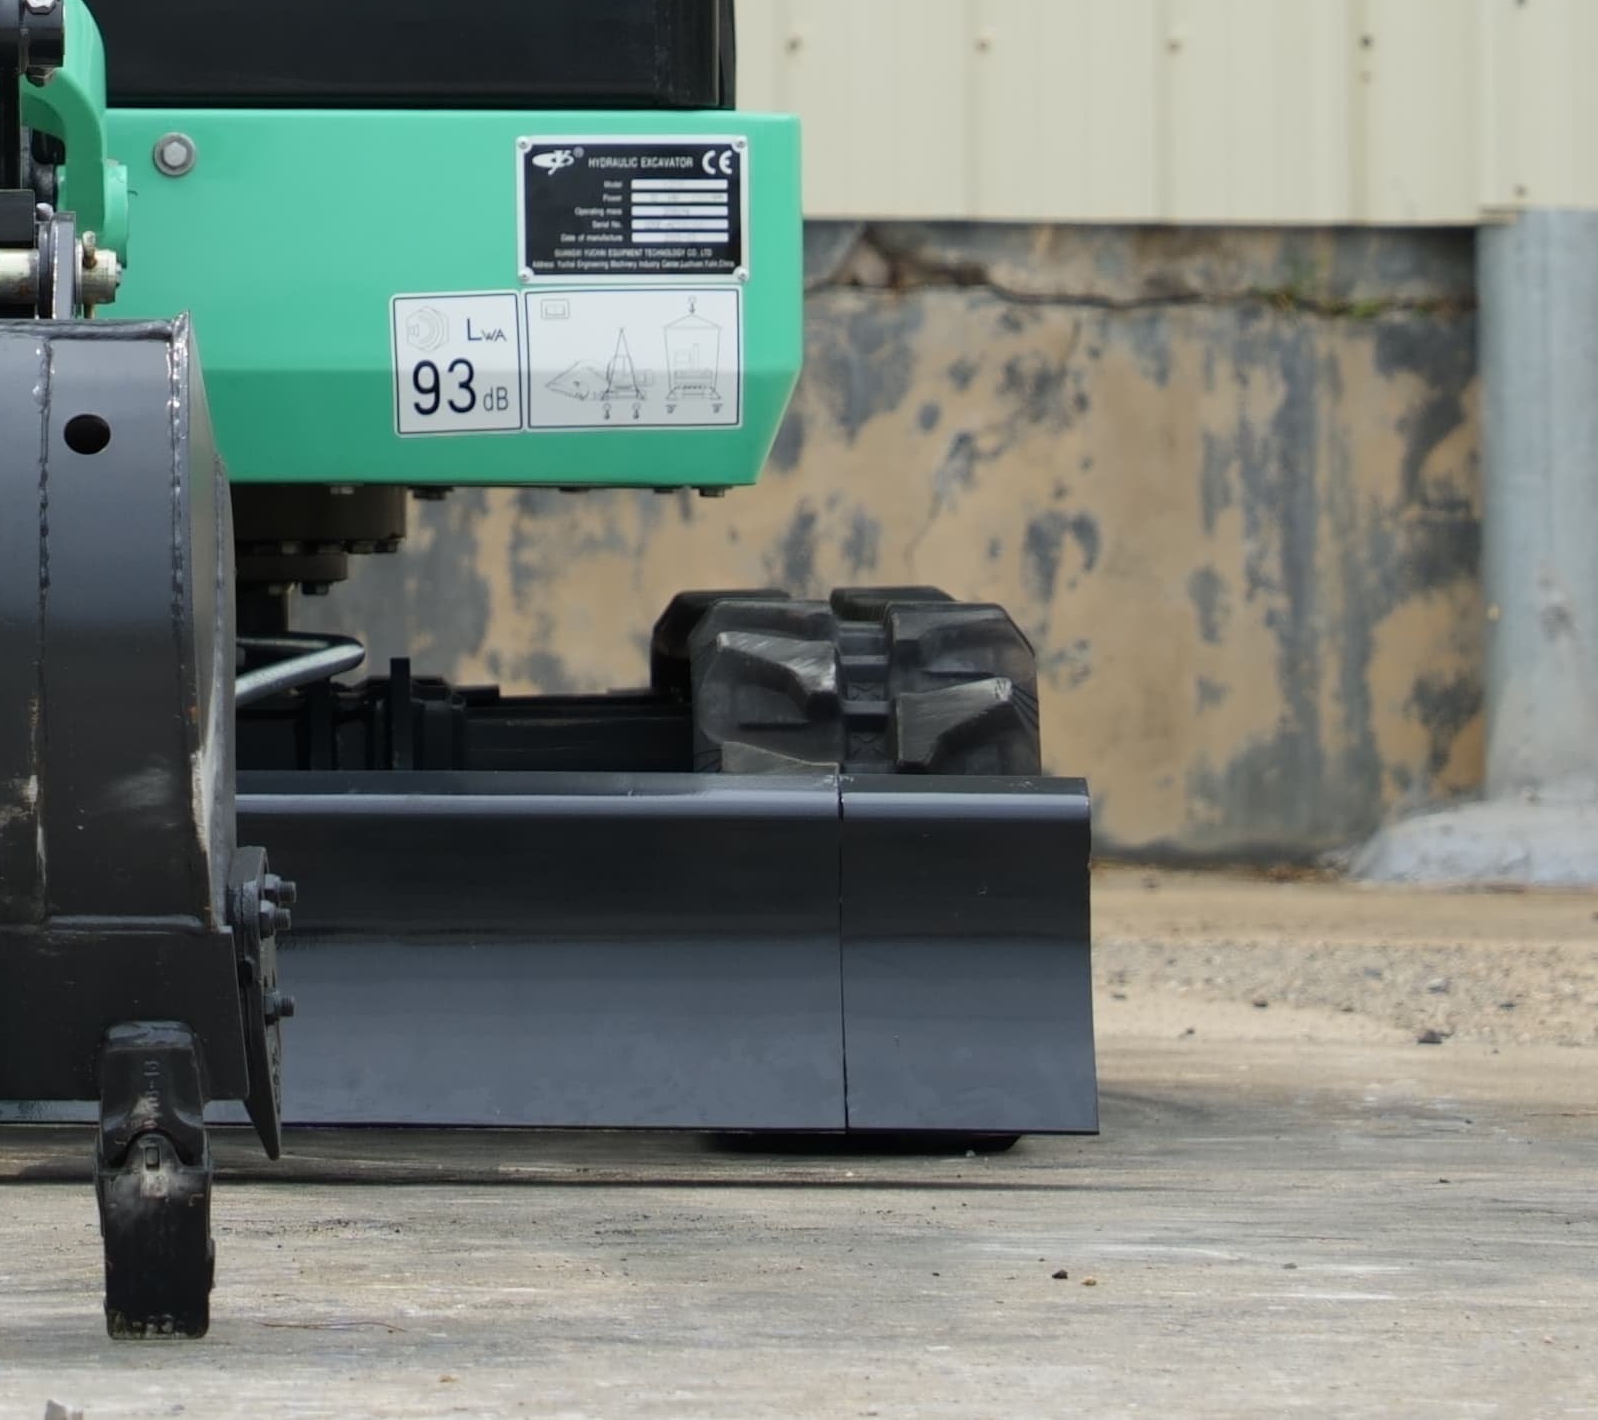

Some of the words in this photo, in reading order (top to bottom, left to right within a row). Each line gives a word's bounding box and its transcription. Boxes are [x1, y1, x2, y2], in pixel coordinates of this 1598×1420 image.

[588, 157, 638, 169] HYDRAULIC
[640, 156, 694, 169] EXCAVATOR
[701, 149, 733, 175] CE
[412, 358, 477, 416] 93
[482, 385, 509, 412] dB
